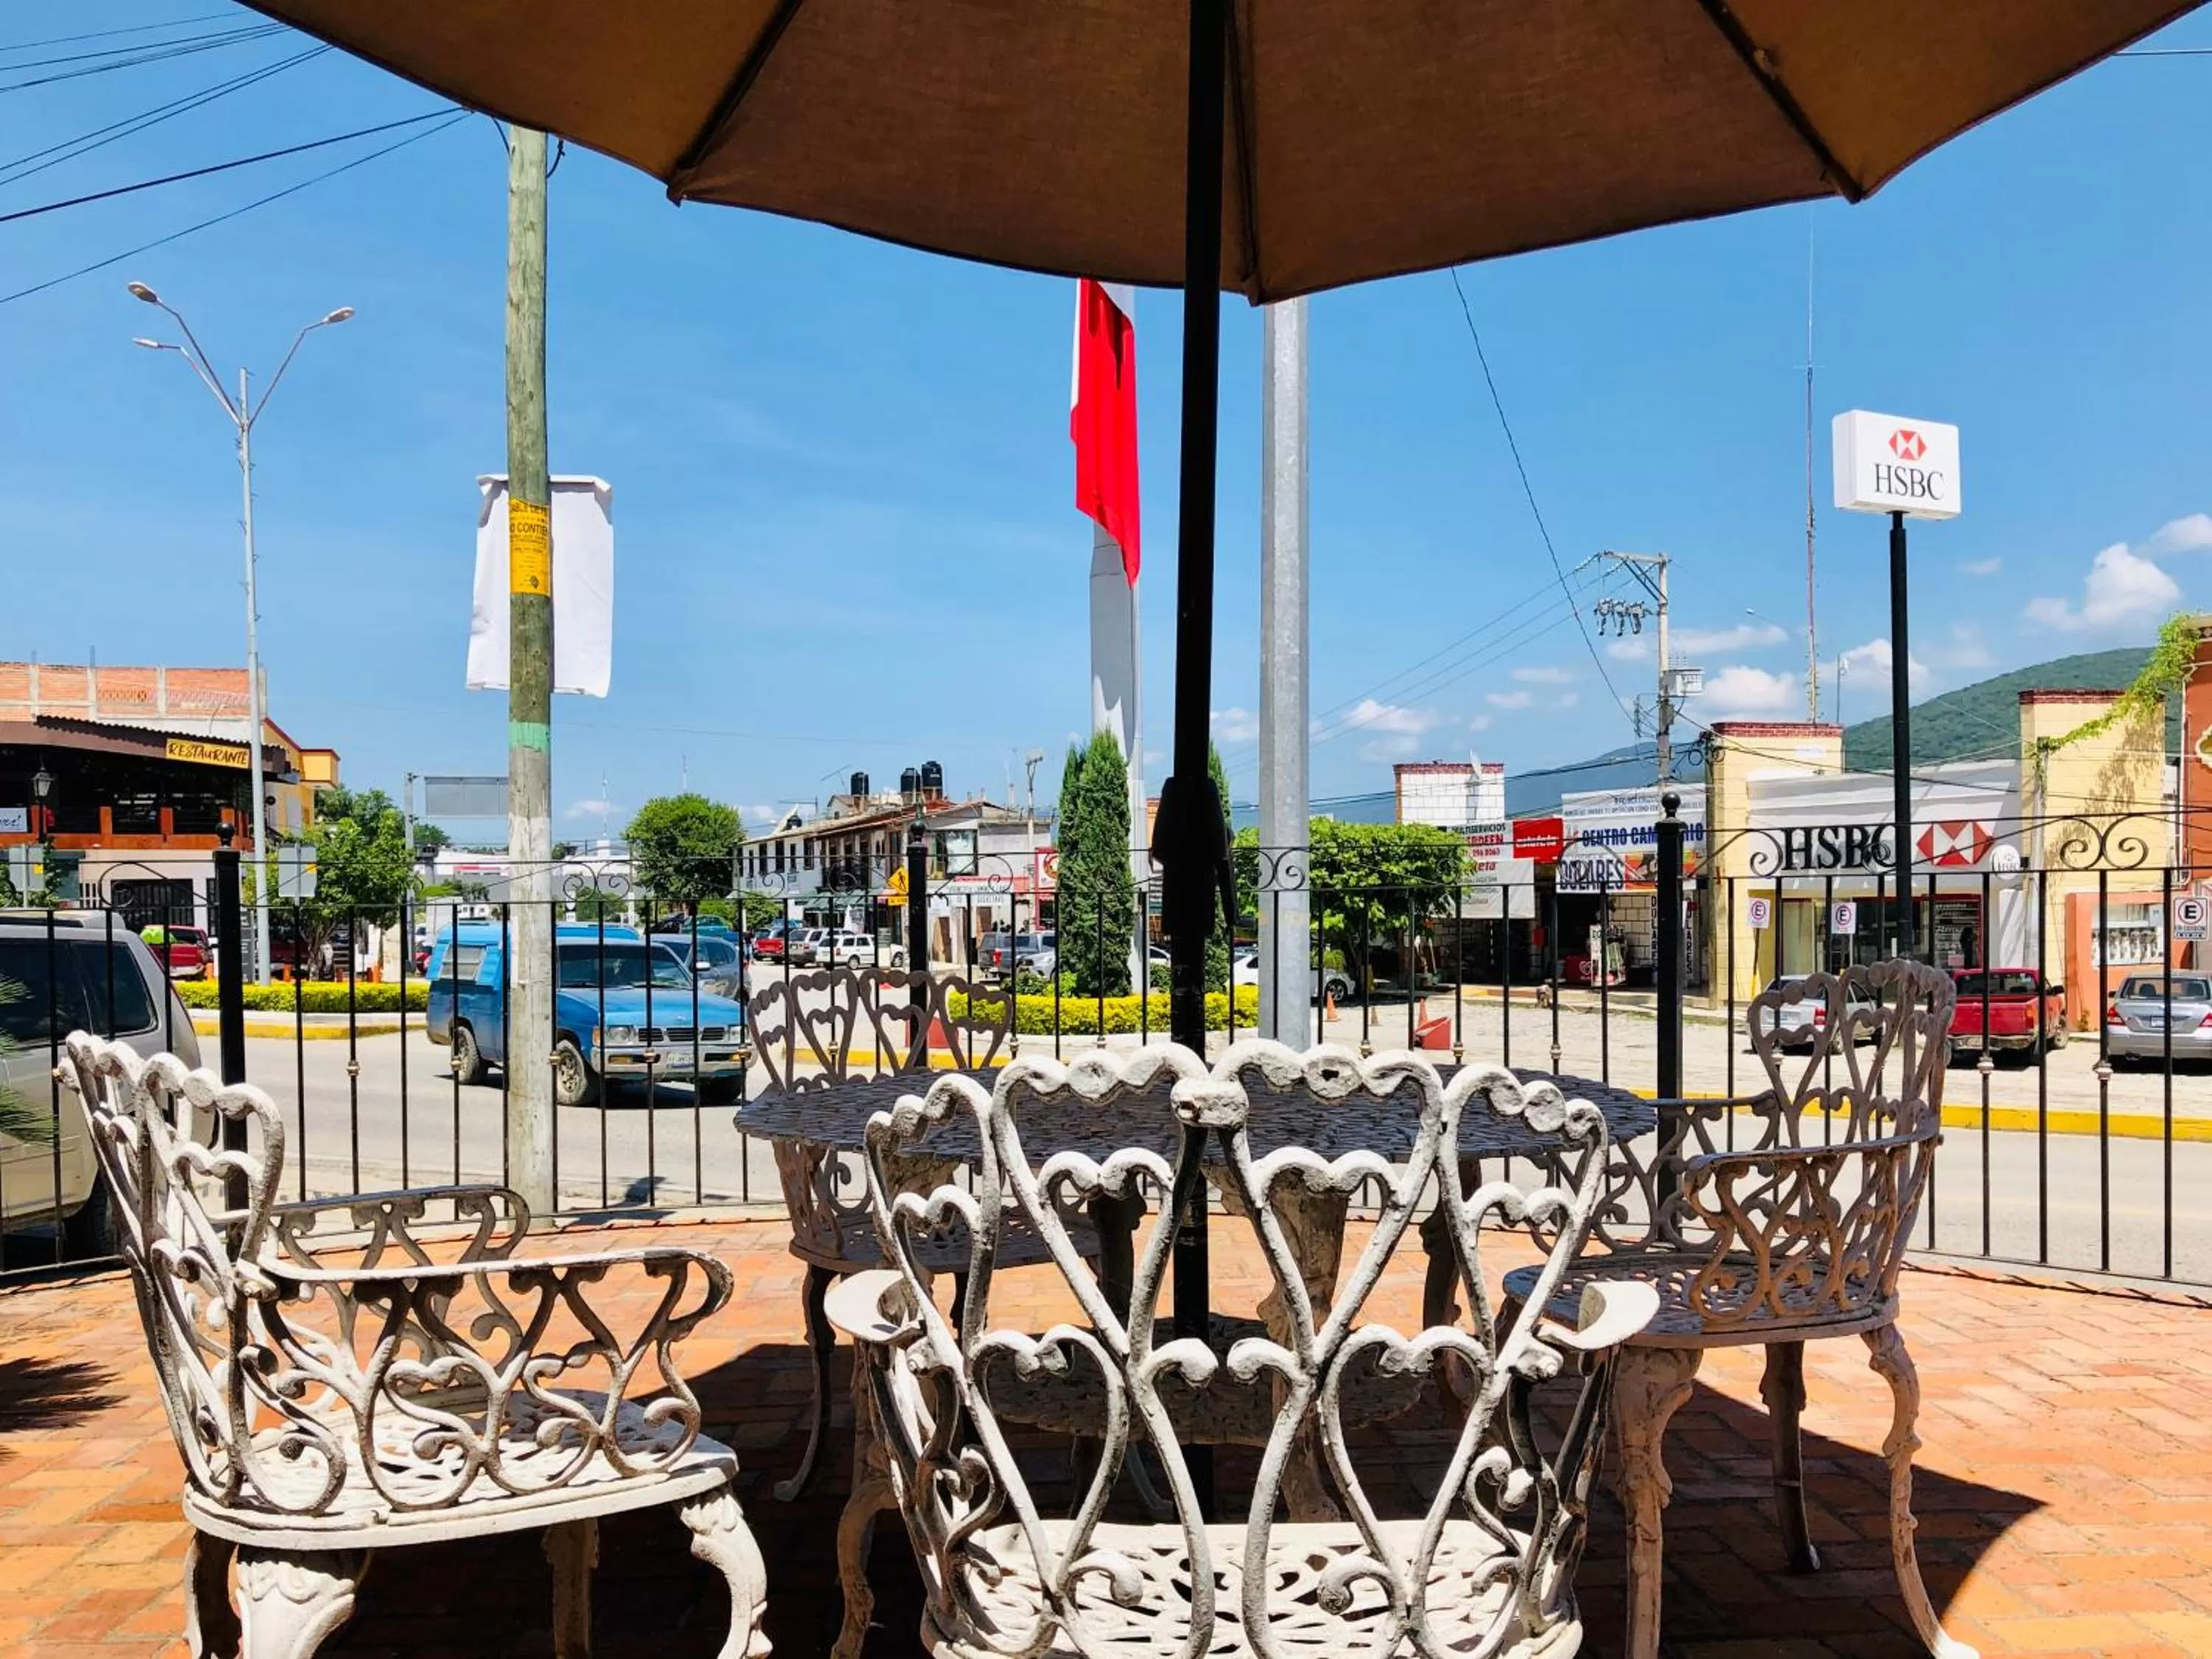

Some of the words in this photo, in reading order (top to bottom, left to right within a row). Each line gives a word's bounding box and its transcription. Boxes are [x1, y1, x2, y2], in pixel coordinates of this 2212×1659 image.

[1874, 462, 1945, 501] HSBC
[168, 742, 248, 765] RESTAURANTE
[1466, 832, 1503, 846] ERDEEN
[1582, 827, 1628, 847] CENTRO
[1781, 825, 1897, 869] HSBC
[1559, 858, 1624, 891] DOLARES
[1755, 905, 1761, 917] E
[1840, 909, 1846, 922] E
[2185, 905, 2197, 919] E
